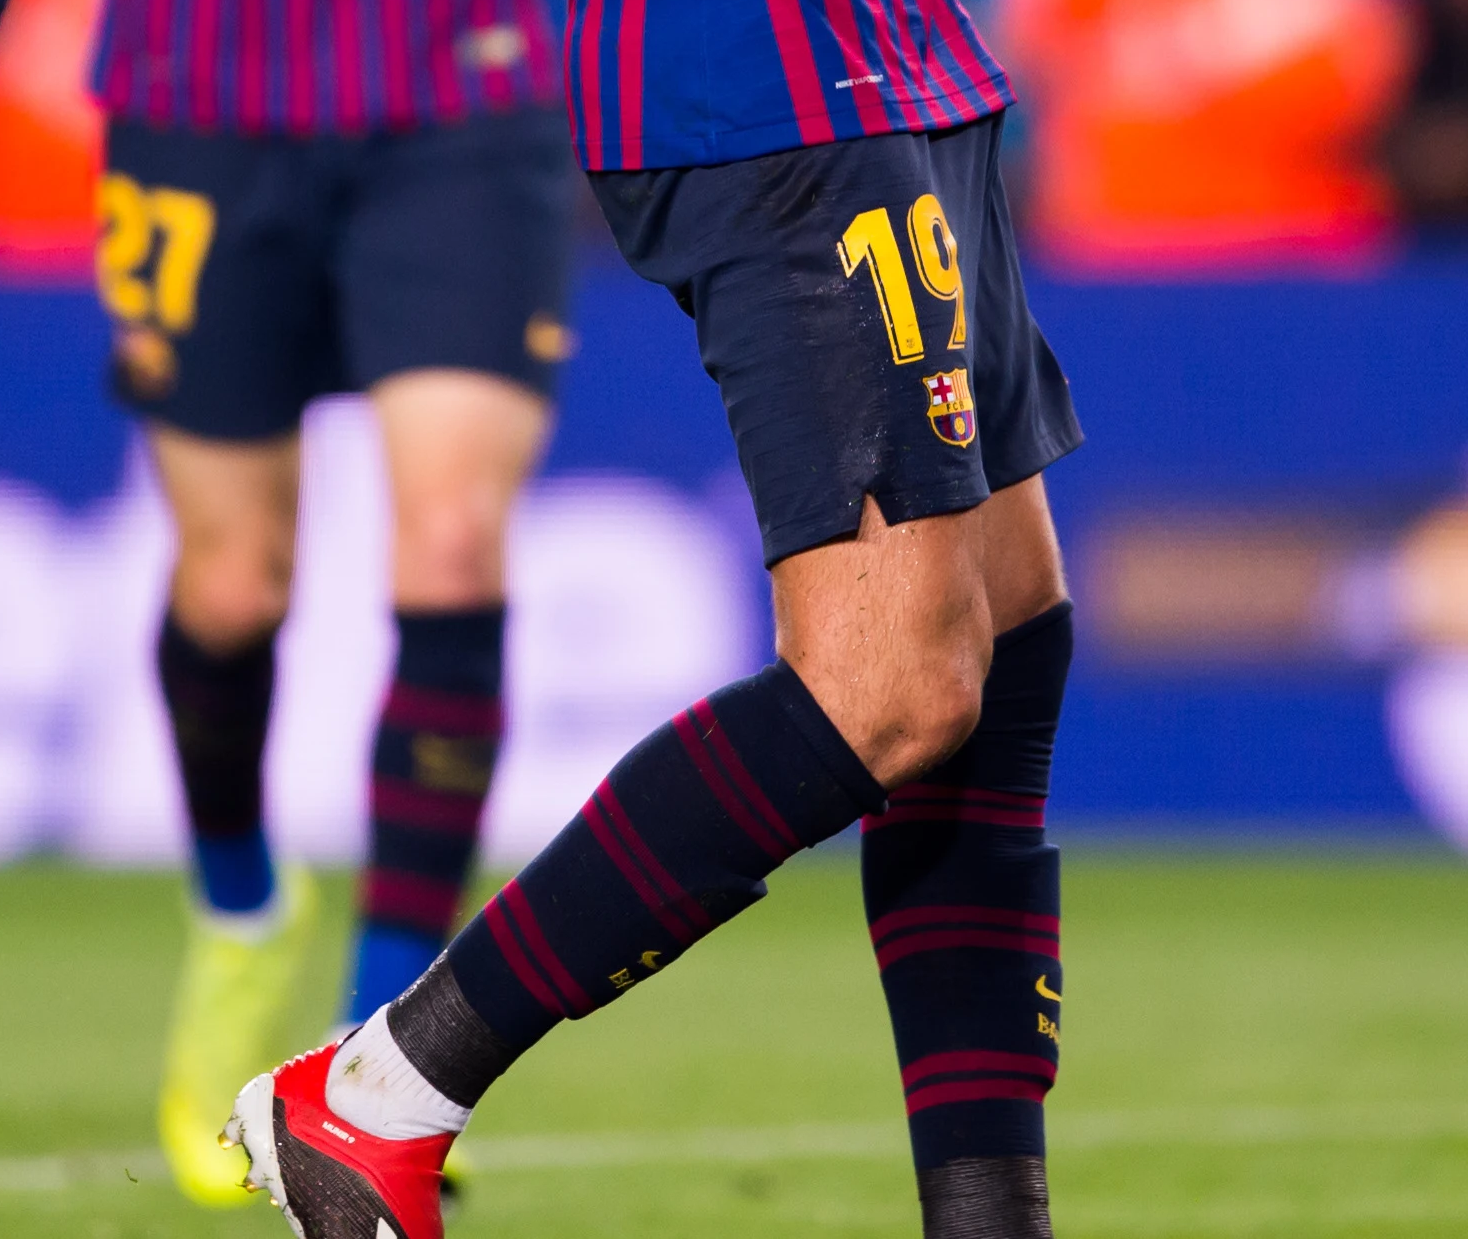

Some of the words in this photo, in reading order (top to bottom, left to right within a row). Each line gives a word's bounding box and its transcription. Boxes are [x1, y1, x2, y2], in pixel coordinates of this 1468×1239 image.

[94, 171, 216, 331] 27
[836, 194, 967, 365] 19
[946, 401, 965, 412] FCB
